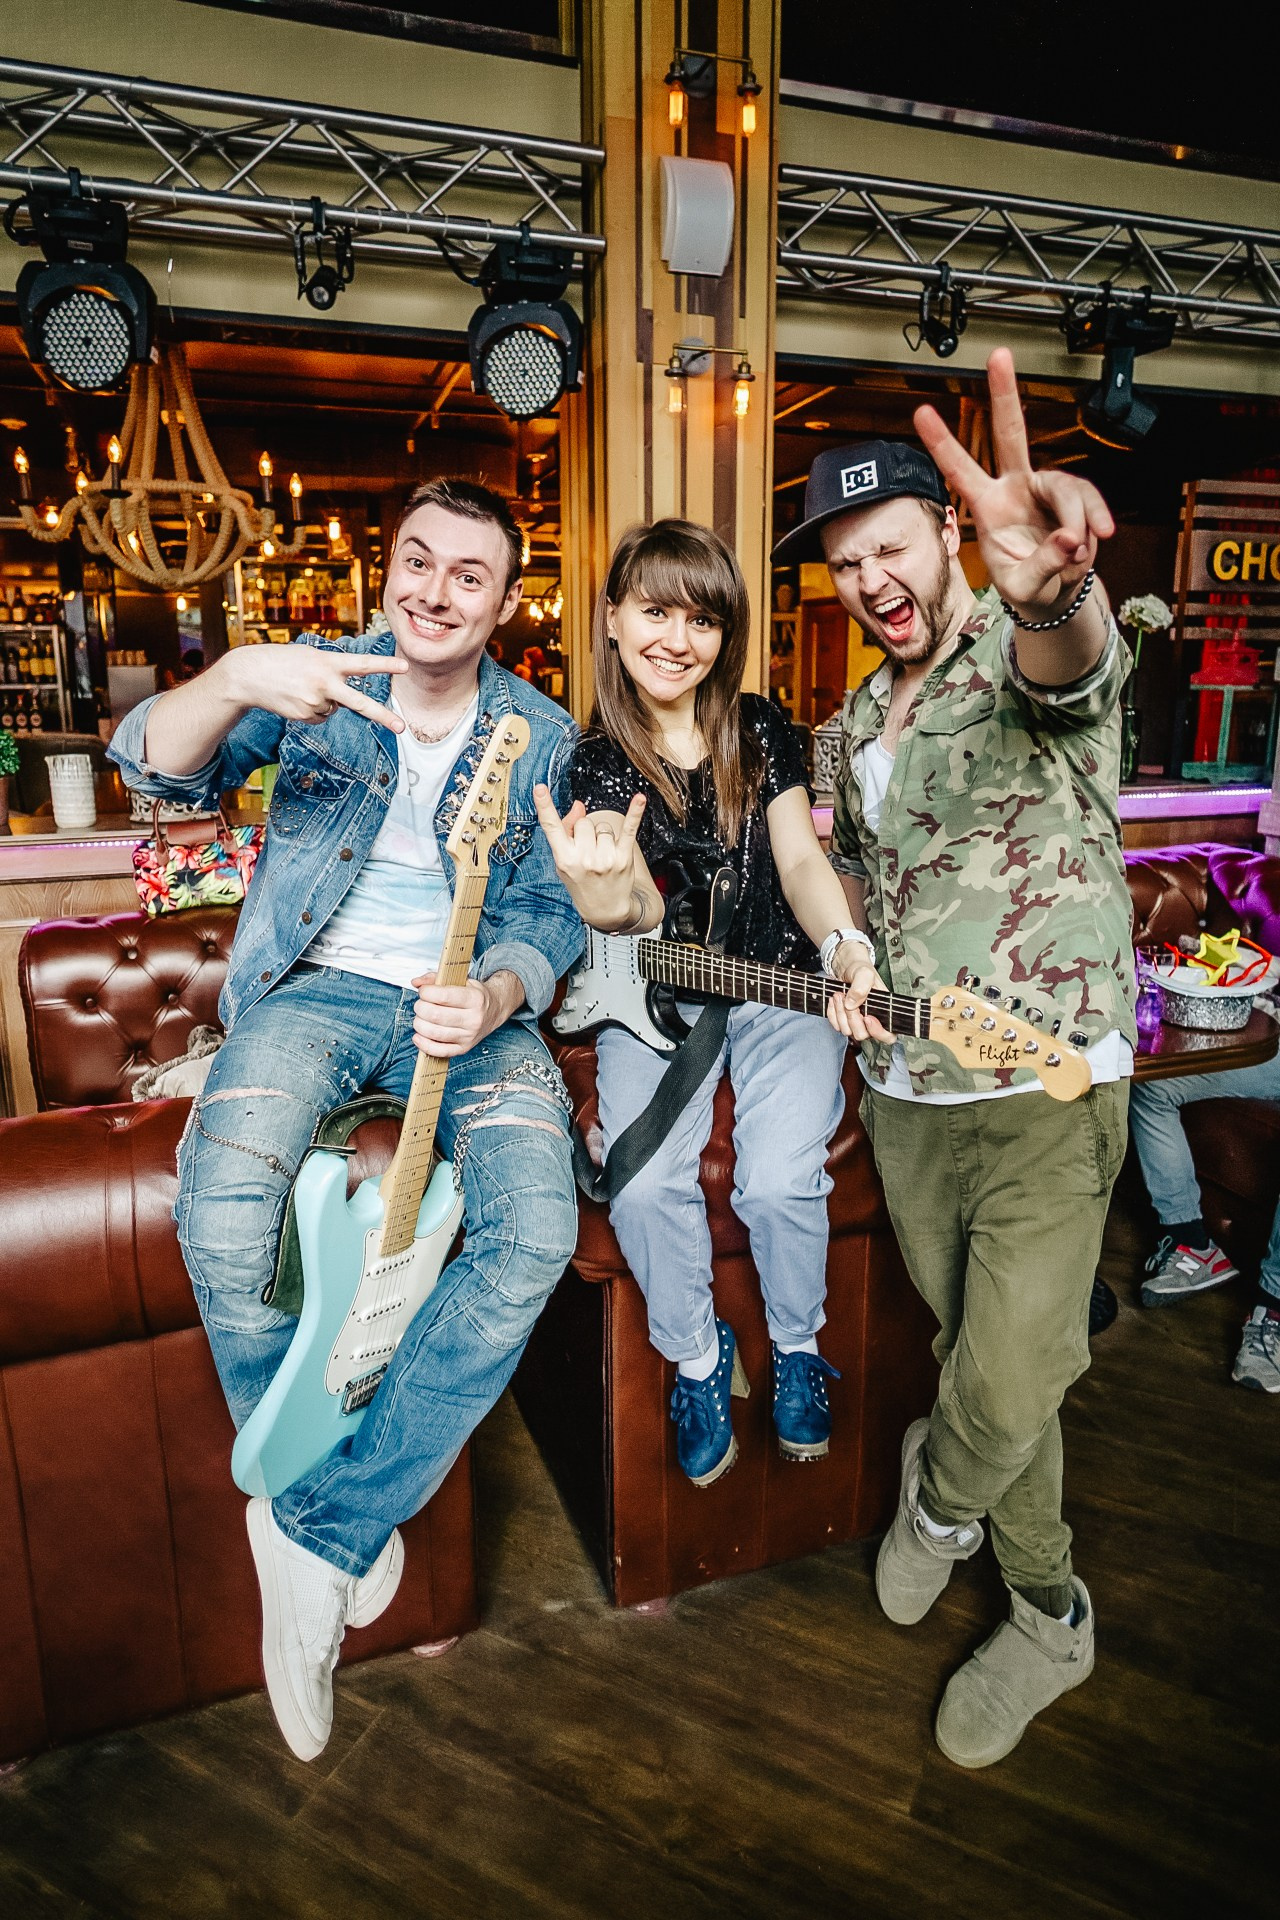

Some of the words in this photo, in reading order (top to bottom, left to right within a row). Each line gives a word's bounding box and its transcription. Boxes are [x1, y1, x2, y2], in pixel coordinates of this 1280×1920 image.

[844, 464, 875, 494] DC
[979, 1044, 1020, 1067] Flight
[1176, 1255, 1200, 1276] N
